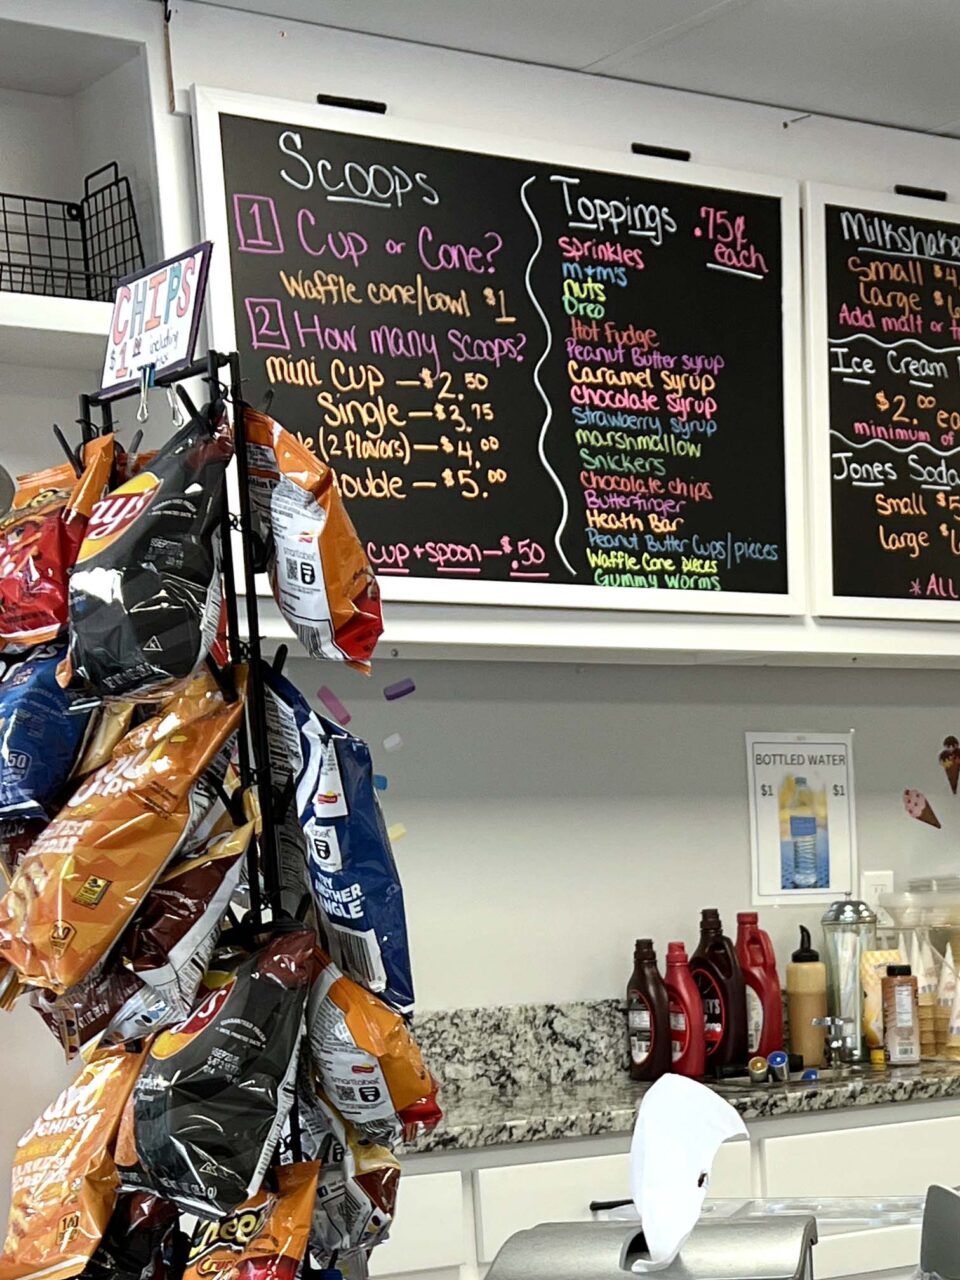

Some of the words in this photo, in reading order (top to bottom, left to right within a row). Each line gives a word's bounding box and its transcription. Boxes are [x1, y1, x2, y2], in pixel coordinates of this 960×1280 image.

[279, 131, 439, 207] Scoops
[550, 175, 677, 245] Toppings
[247, 203, 273, 247] 1
[297, 208, 368, 268] Cup
[386, 239, 405, 254] or
[418, 225, 503, 274] Cone?
[714, 243, 768, 272] each
[113, 256, 195, 346] CHIPS
[279, 270, 363, 305] Waffle
[367, 273, 471, 318] cone/bowl
[483, 287, 517, 323] $1
[563, 276, 606, 302] nuts
[562, 295, 605, 319] Oreo
[839, 302, 875, 328] Add
[882, 313, 923, 334] malt
[930, 321, 944, 332] or
[254, 306, 281, 335] 2
[294, 310, 357, 350] How
[370, 325, 441, 380] many
[570, 316, 600, 341] Hot
[565, 337, 624, 363] Peanut
[631, 347, 676, 369] Butter
[681, 354, 725, 376] syrup
[830, 348, 876, 374] Ice
[887, 350, 949, 378] Cream
[568, 360, 654, 387] Caramel
[317, 391, 406, 439] Single
[571, 406, 662, 437] Strawberry
[670, 417, 717, 439] syrup
[875, 391, 936, 425] $2.00
[345, 430, 412, 464] flavors)
[575, 428, 701, 458] marshmallow
[853, 421, 931, 442] minimum
[940, 434, 955, 446] of
[579, 448, 666, 476] Snickers
[832, 453, 897, 480] Jones
[668, 477, 713, 500] chips
[583, 489, 686, 519] Butterfinger
[585, 509, 643, 531] Heath
[648, 510, 684, 533] Bar
[585, 527, 638, 548] Peanut
[645, 533, 689, 551] Butter
[586, 547, 637, 570] Waffle
[641, 551, 675, 570] Cone
[594, 569, 658, 589] Gummy
[756, 754, 805, 765] BOTTLED
[808, 754, 846, 766] WATER
[761, 784, 774, 796] $1
[833, 784, 845, 796] $1
